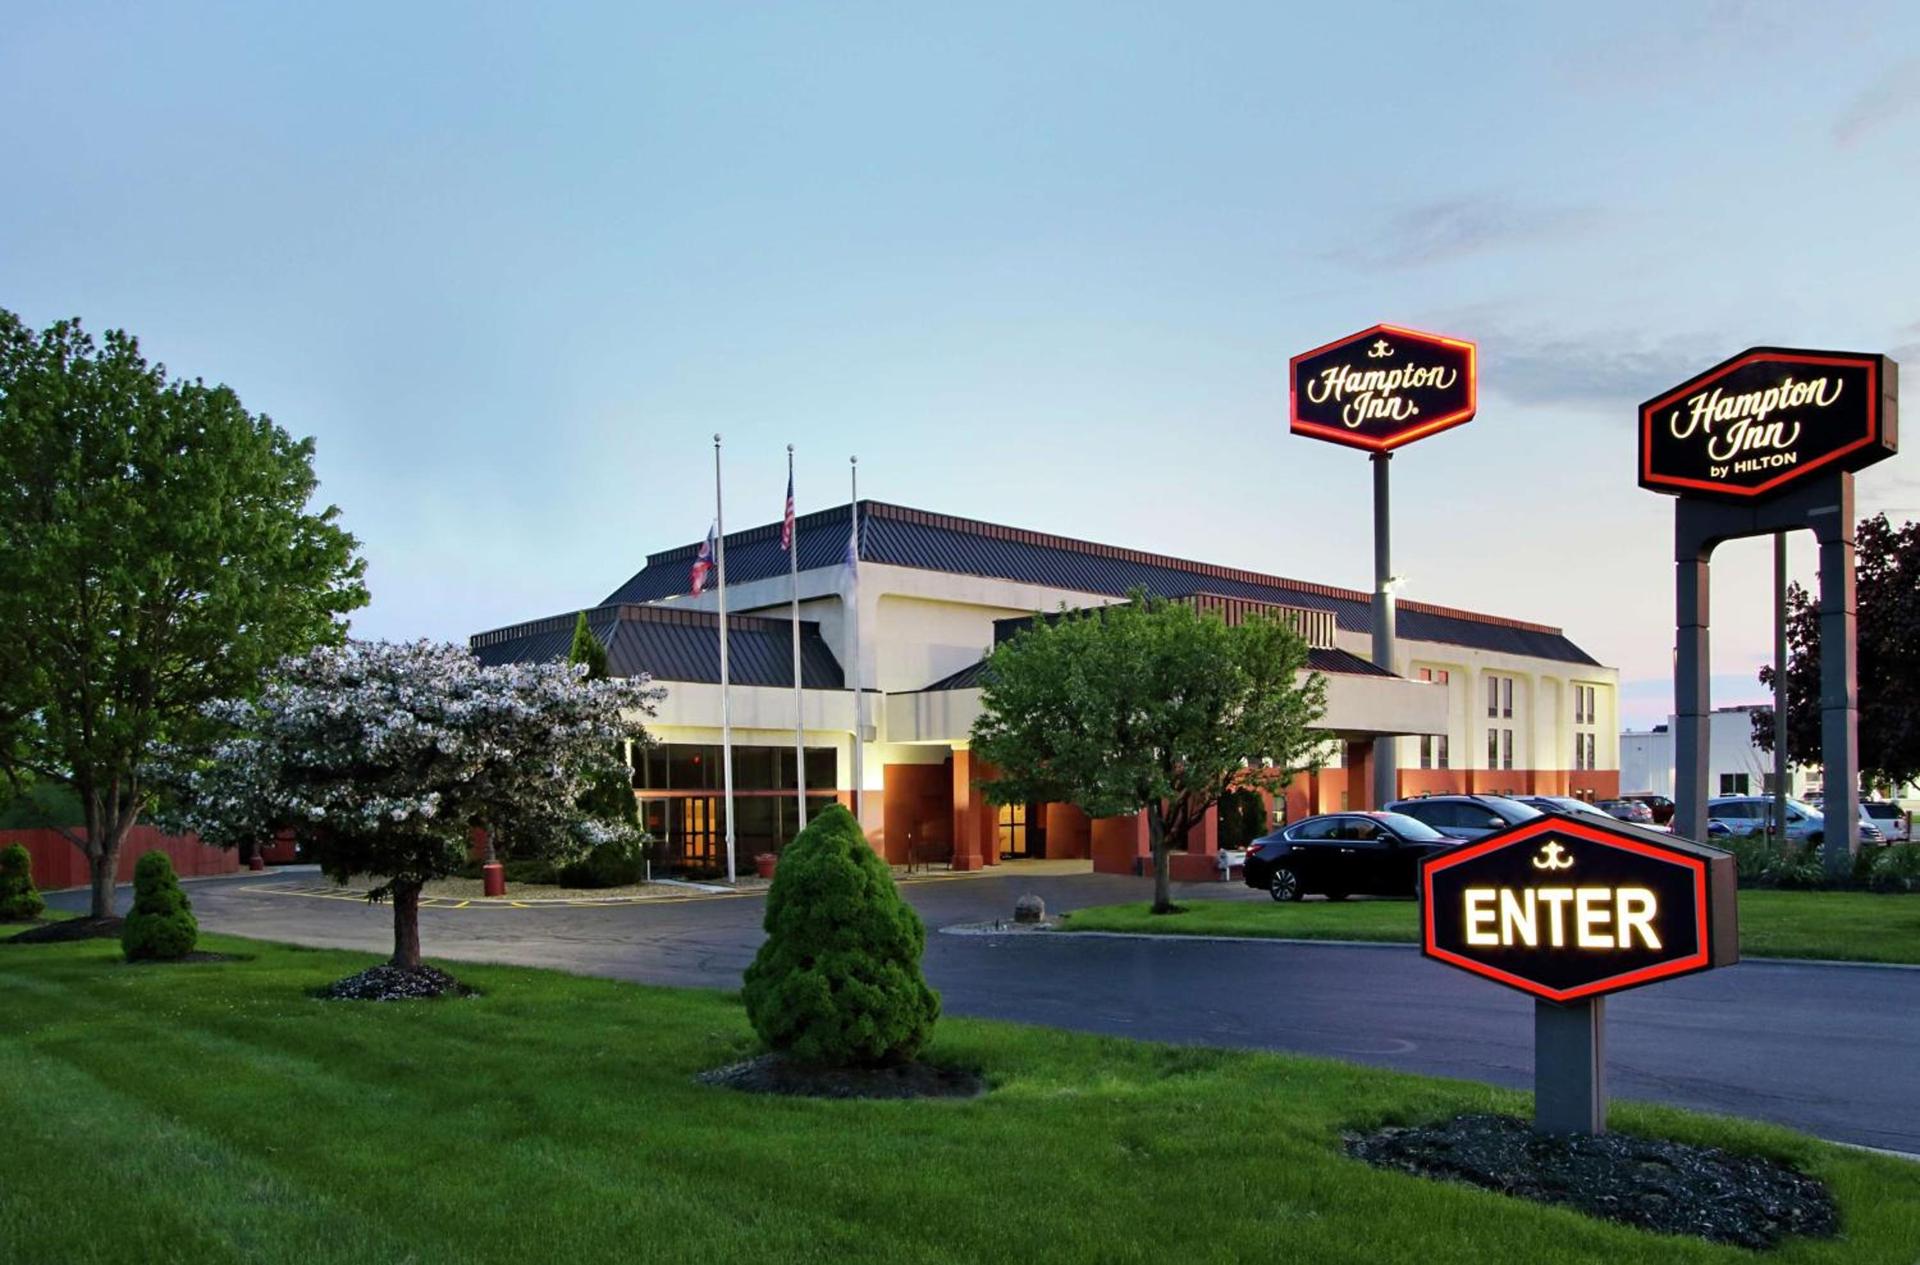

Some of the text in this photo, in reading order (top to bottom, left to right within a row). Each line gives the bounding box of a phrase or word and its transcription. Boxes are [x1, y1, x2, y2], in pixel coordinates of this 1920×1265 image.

[1307, 362, 1457, 403] Hampton
[1343, 391, 1415, 428] Inn
[1670, 377, 1843, 439] Hampton
[1708, 418, 1800, 461] Inn
[1710, 451, 1797, 479] by HILTON
[1464, 886, 1662, 950] ENTER
